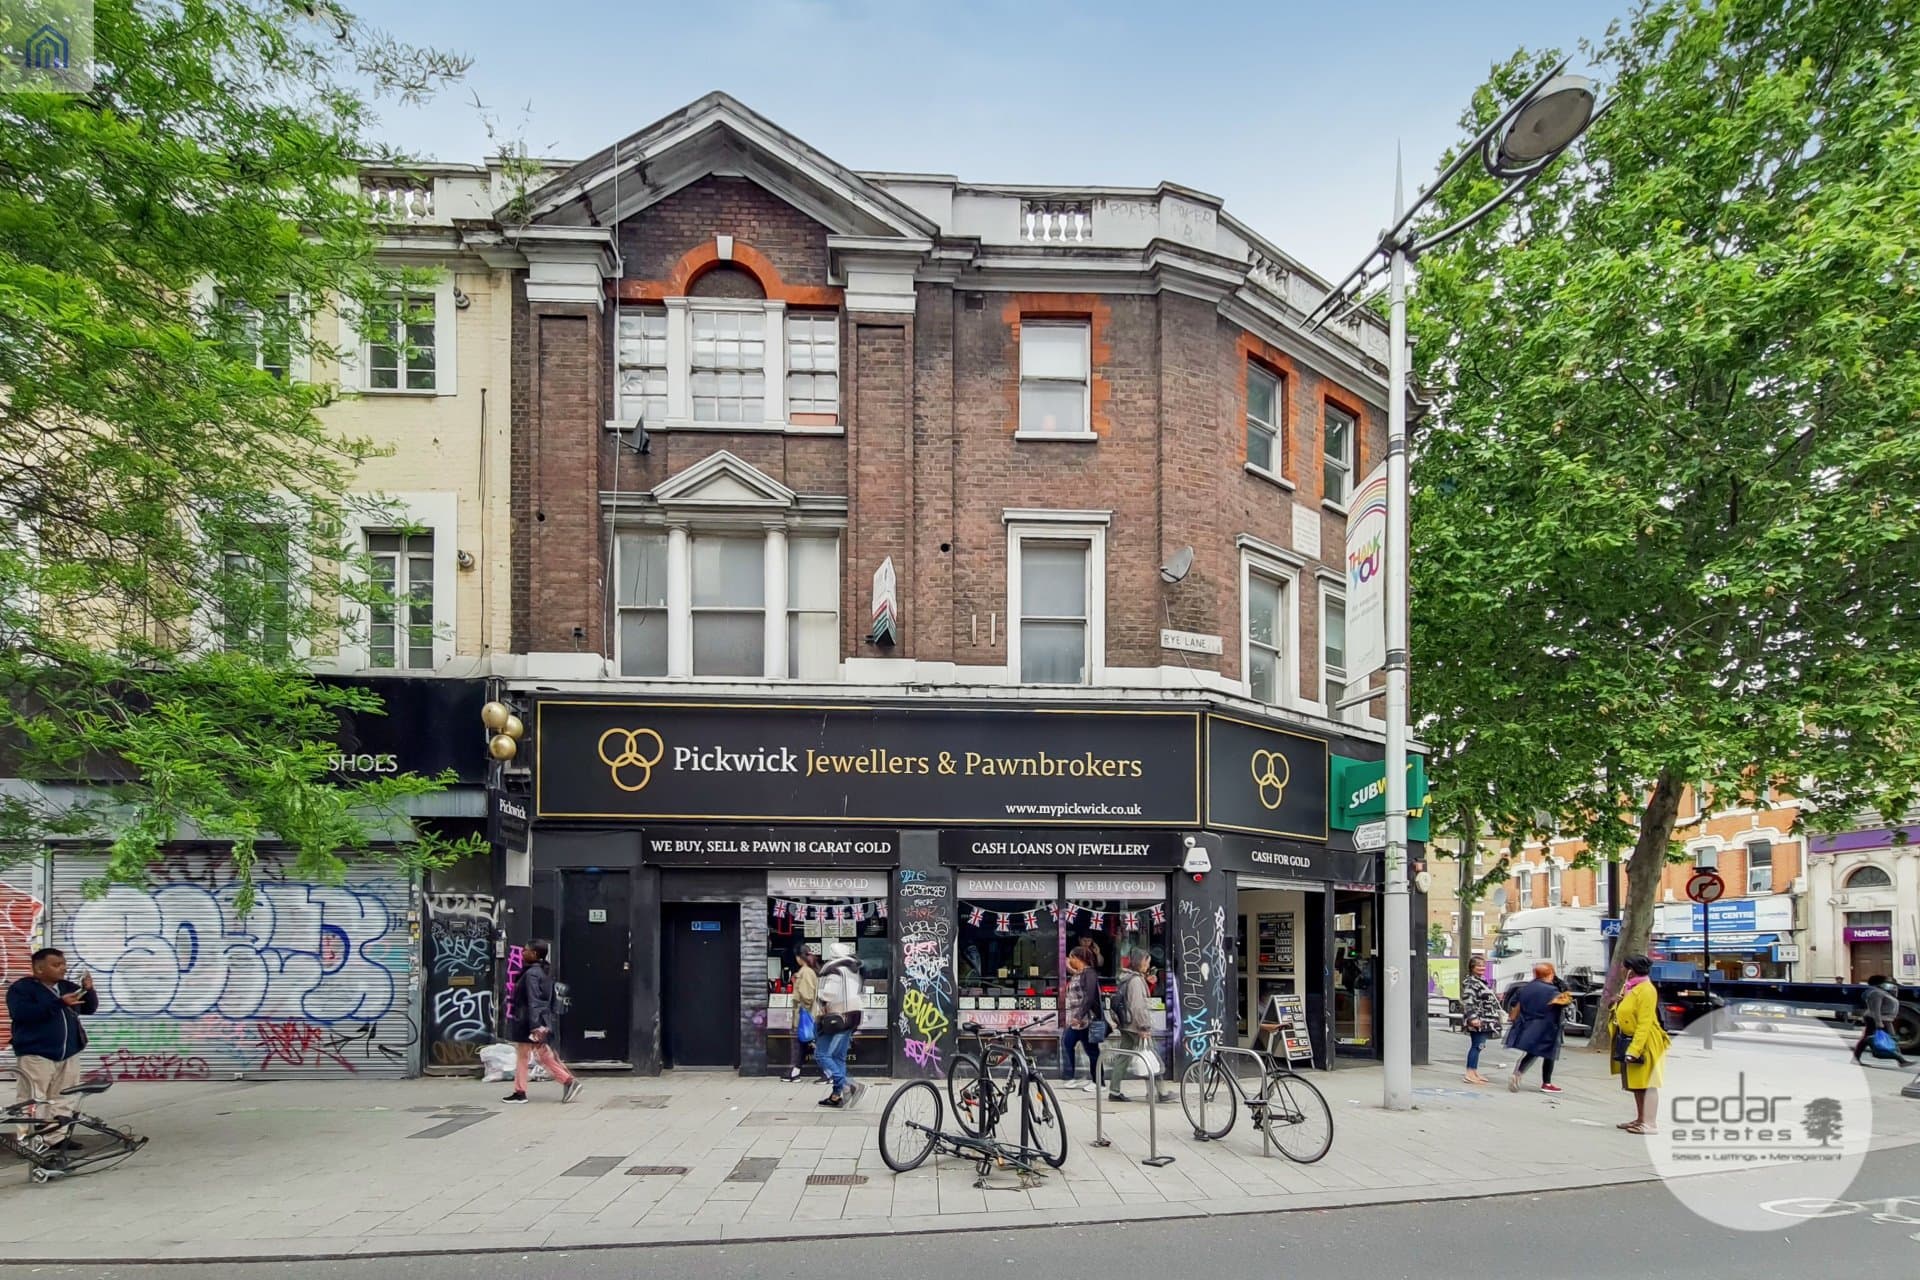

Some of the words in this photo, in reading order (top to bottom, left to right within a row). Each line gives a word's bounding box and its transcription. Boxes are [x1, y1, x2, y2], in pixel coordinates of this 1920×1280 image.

[1349, 530, 1381, 568] THANK
[1350, 548, 1381, 590] YOU
[1185, 638, 1207, 649] LANE
[328, 754, 398, 772] SHOES
[673, 746, 799, 773] Pickwick
[806, 749, 929, 777] Jewellers
[937, 751, 957, 775] &
[964, 751, 1143, 777] Pawnbrokers
[499, 798, 527, 819] Pickwick
[1005, 803, 1143, 817] www.mypickwick.co.uk
[650, 840, 673, 852] WE
[675, 840, 705, 854] BUY,
[707, 840, 738, 852] SELL
[740, 841, 750, 852] &
[752, 841, 791, 853] PAWN
[794, 841, 806, 853] 18
[809, 841, 852, 853] CARAT
[854, 842, 891, 853] GOLD
[972, 842, 1007, 854] CASH
[1010, 843, 1052, 855] LOANS
[1055, 843, 1075, 855] ON
[1078, 844, 1150, 856] JEWELLERY
[1251, 851, 1273, 864] CASH
[1273, 853, 1289, 866] FOR
[1289, 855, 1310, 868] GOLD
[787, 878, 807, 888] WE
[809, 878, 833, 888] BUY
[835, 879, 868, 889] GOLD
[969, 880, 1004, 891] PAWN
[1006, 881, 1046, 891] LOANS
[1075, 881, 1094, 891] WE
[1097, 881, 1122, 891] BUY
[1122, 881, 1155, 892] GOLD
[1853, 929, 1890, 937] NatWest
